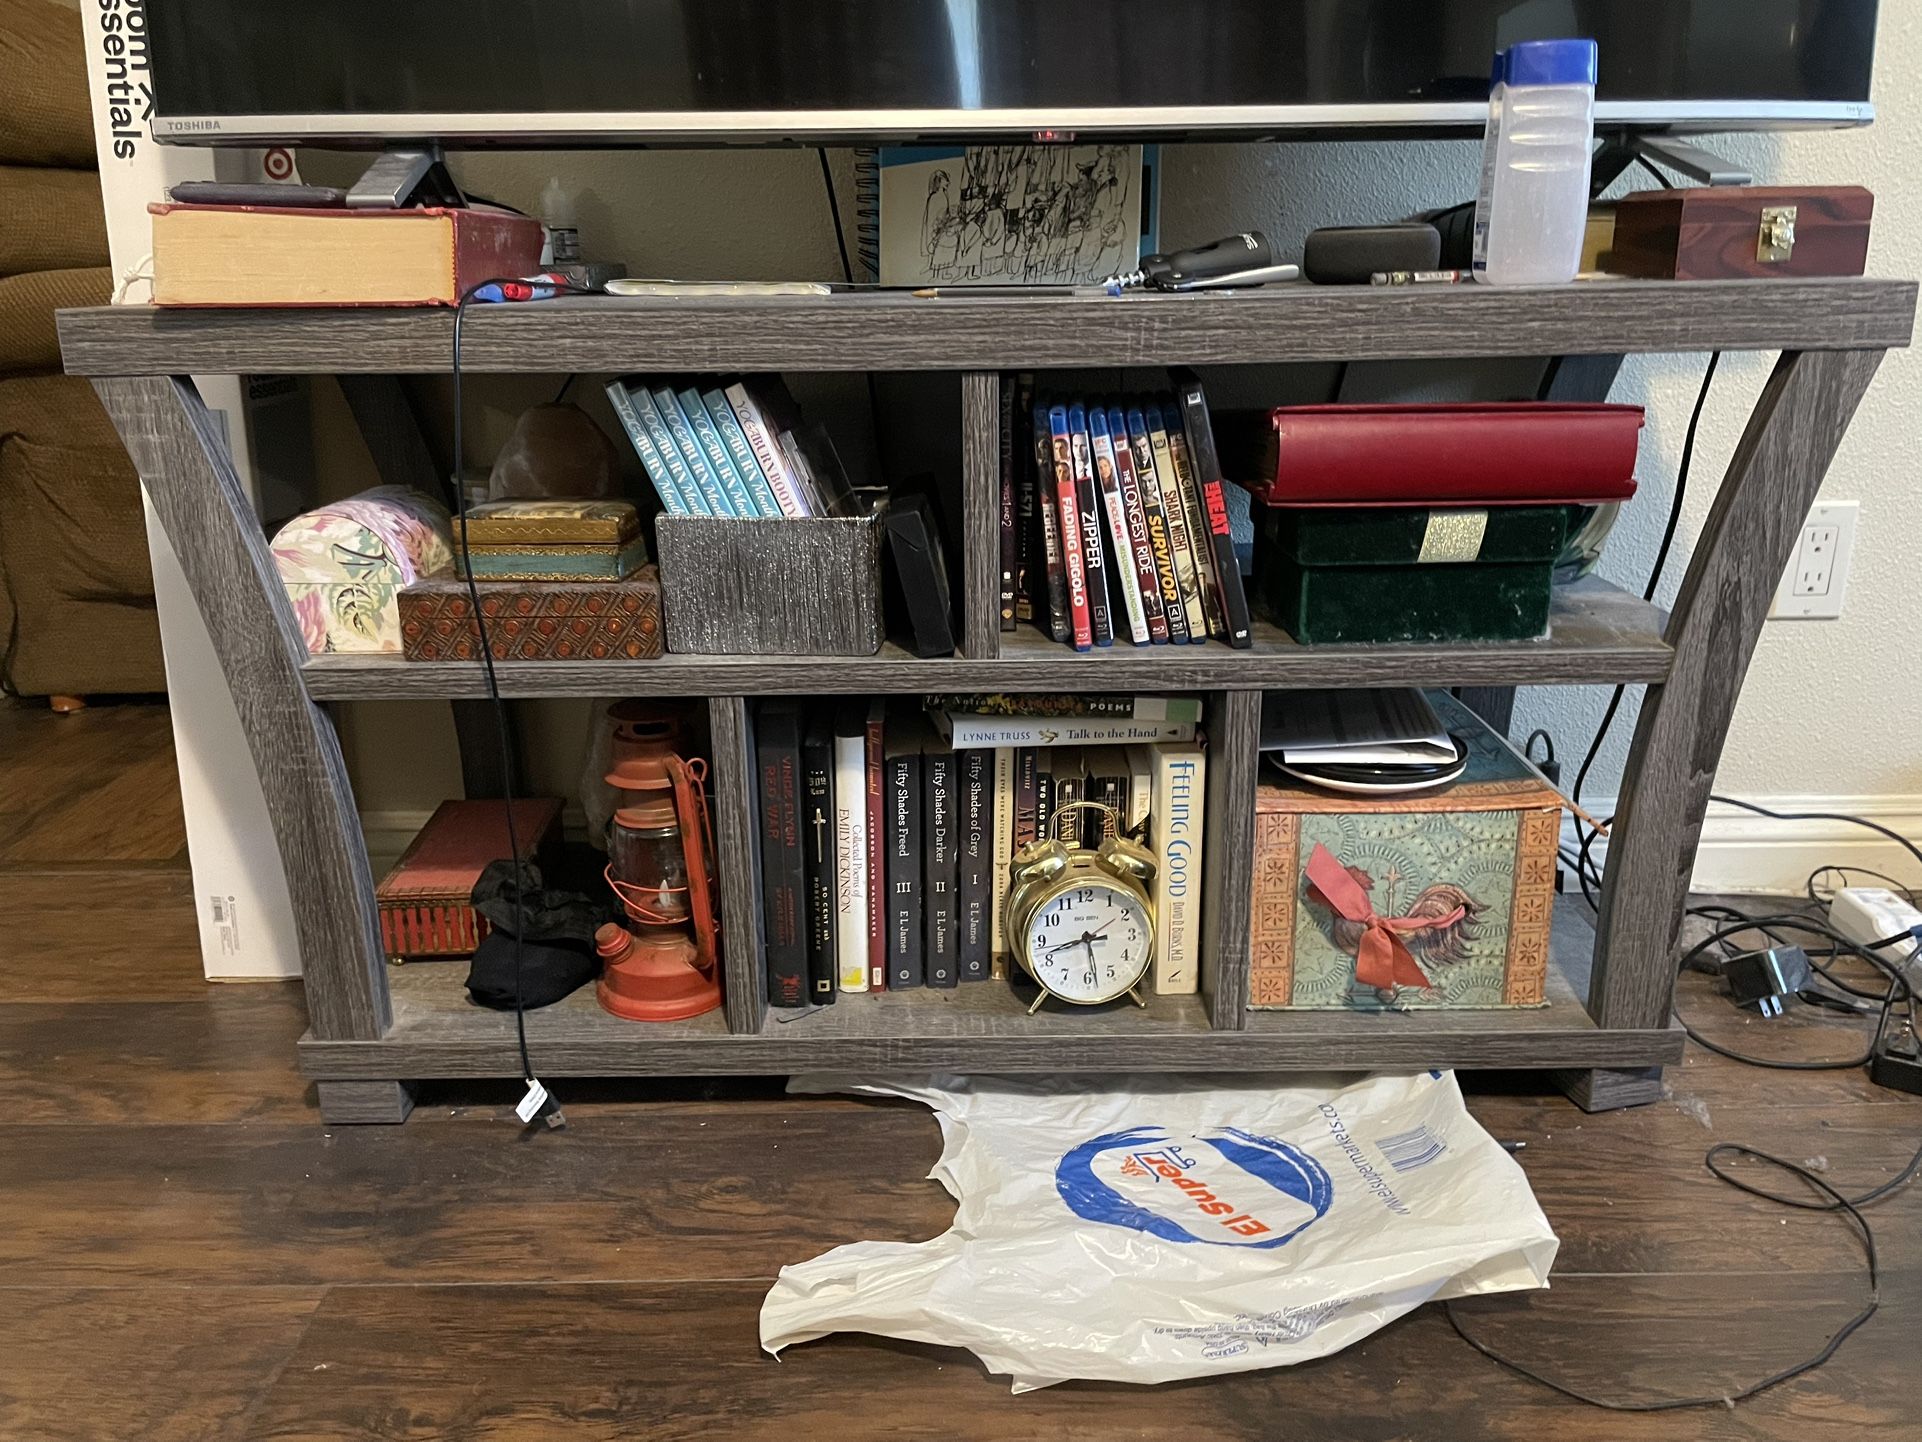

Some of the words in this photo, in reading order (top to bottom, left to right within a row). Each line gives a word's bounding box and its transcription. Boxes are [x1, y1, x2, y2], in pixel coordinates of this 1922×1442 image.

[98, 0, 142, 160] ssentials
[167, 121, 221, 131] TOSHIBA
[617, 401, 667, 480] YOGABURN
[640, 404, 690, 482] YOGABURN
[664, 404, 710, 485] YOGABURN
[691, 410, 736, 489] YOGABURN
[713, 401, 759, 482] YOGABURN
[735, 401, 776, 472] YOGABURN
[1122, 469, 1132, 484] THE
[1123, 484, 1146, 545] LONGEST
[1164, 490, 1181, 525] SHARK
[1205, 488, 1230, 536] HEAT
[1061, 496, 1083, 551] FADING
[1081, 510, 1102, 569] ZIPPER
[1170, 524, 1188, 553] NIGHT
[1136, 546, 1153, 574] RIDE
[1148, 515, 1178, 601] SURVIVOR
[1069, 553, 1084, 607] GIGOLO
[1090, 702, 1132, 711] POEMS
[963, 732, 997, 741] LYNNE
[999, 731, 1031, 740] TRUSS
[1067, 729, 1090, 739] Talk
[1093, 729, 1104, 738] to
[1108, 728, 1124, 738] the
[1127, 727, 1158, 738] Hand
[896, 763, 909, 787] Fifty
[933, 762, 946, 787] Fifty
[969, 756, 982, 780] Fifty
[971, 782, 982, 819] Shades
[1038, 779, 1047, 799] TWO
[1169, 760, 1195, 834] FEELING
[898, 789, 909, 826] Shades
[935, 788, 946, 825] Shades
[1038, 803, 1047, 821] OLD
[839, 808, 850, 846] EMILY
[971, 820, 982, 831] of
[851, 824, 861, 858] Collected
[898, 827, 910, 857] Freed
[935, 827, 947, 863] Darker
[968, 832, 981, 858] Grey
[840, 847, 852, 913] DICKINSON
[852, 860, 862, 886] Poems
[1166, 839, 1192, 897] GOOD
[935, 882, 946, 892] II
[1077, 889, 1094, 903] 12
[1106, 894, 1112, 907] 1
[1058, 898, 1072, 911] 11
[1120, 908, 1130, 922] 2
[1172, 901, 1185, 919] DAVID
[970, 917, 979, 945] James
[1045, 913, 1060, 927] 10
[900, 926, 909, 954] James
[937, 926, 946, 954] James
[1037, 934, 1046, 948] 9
[1127, 928, 1136, 941] 3
[1045, 954, 1054, 967] 8
[1120, 948, 1129, 961] 4
[1060, 968, 1069, 981] 7
[1083, 972, 1092, 985] 6
[1106, 965, 1115, 978] 5
[1142, 1156, 1234, 1215] Super
[1219, 1214, 1272, 1236] El
